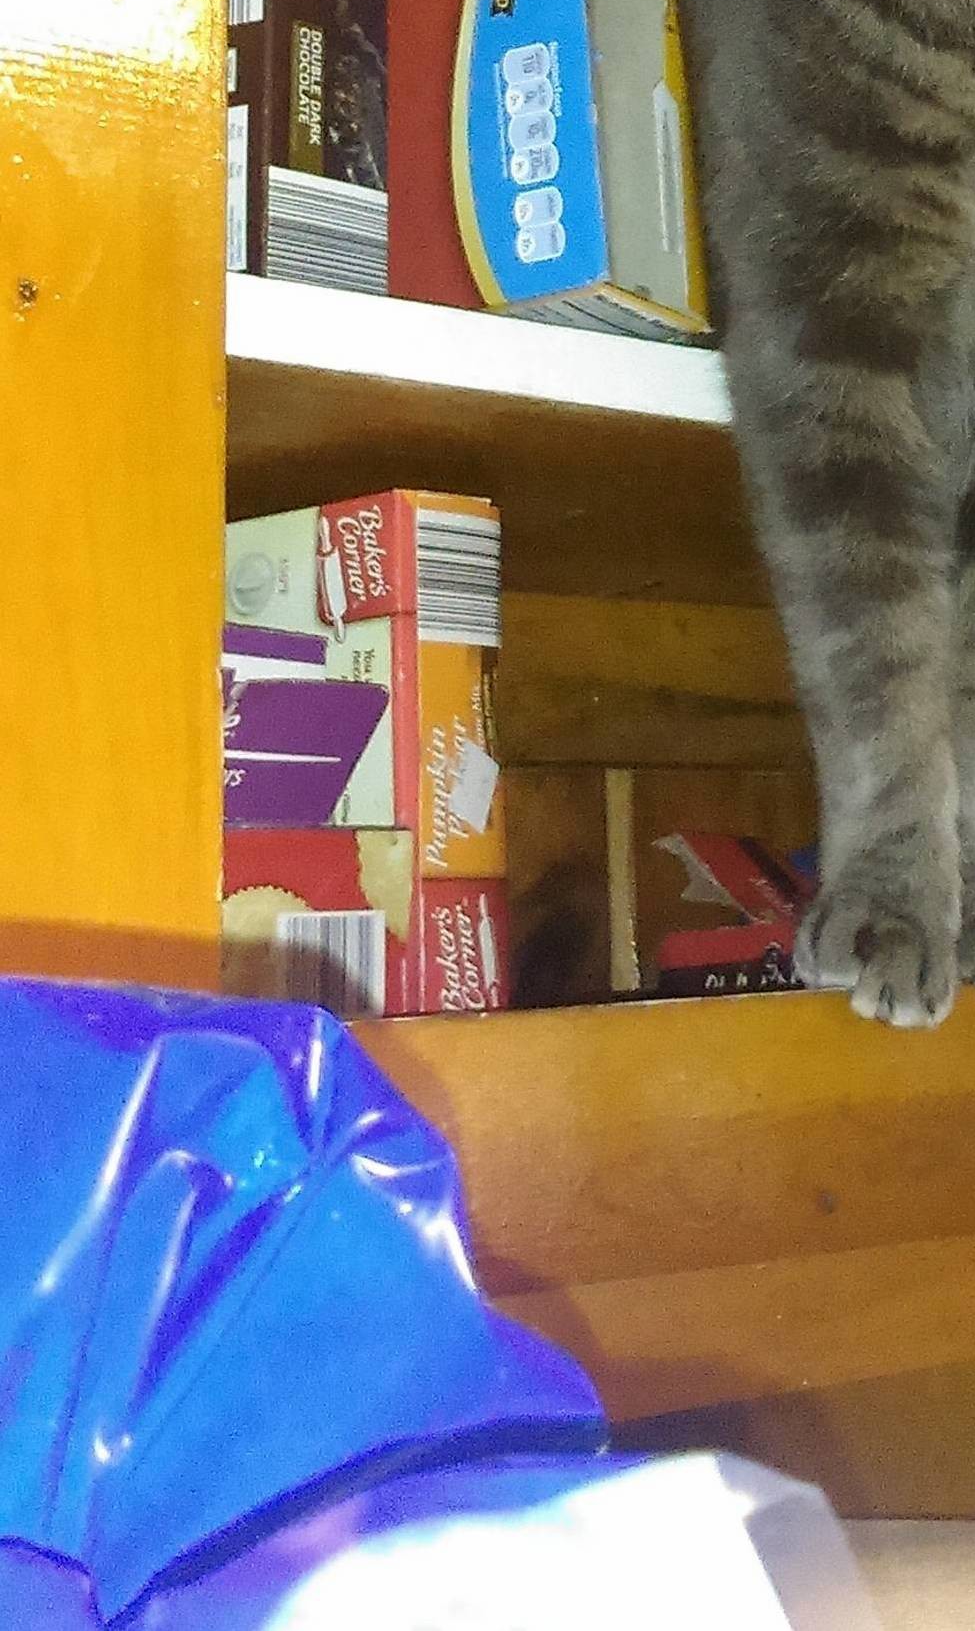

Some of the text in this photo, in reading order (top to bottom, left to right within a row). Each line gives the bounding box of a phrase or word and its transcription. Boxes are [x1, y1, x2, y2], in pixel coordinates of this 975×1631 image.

[298, 26, 310, 125] CHOCOLATE
[309, 29, 323, 146] DOUBLE DARK
[337, 515, 367, 601] Corner
[358, 504, 392, 598] Baker's
[426, 724, 450, 868] Pumpkin
[431, 905, 464, 1011] Baker's
[456, 904, 486, 1011] Corner
